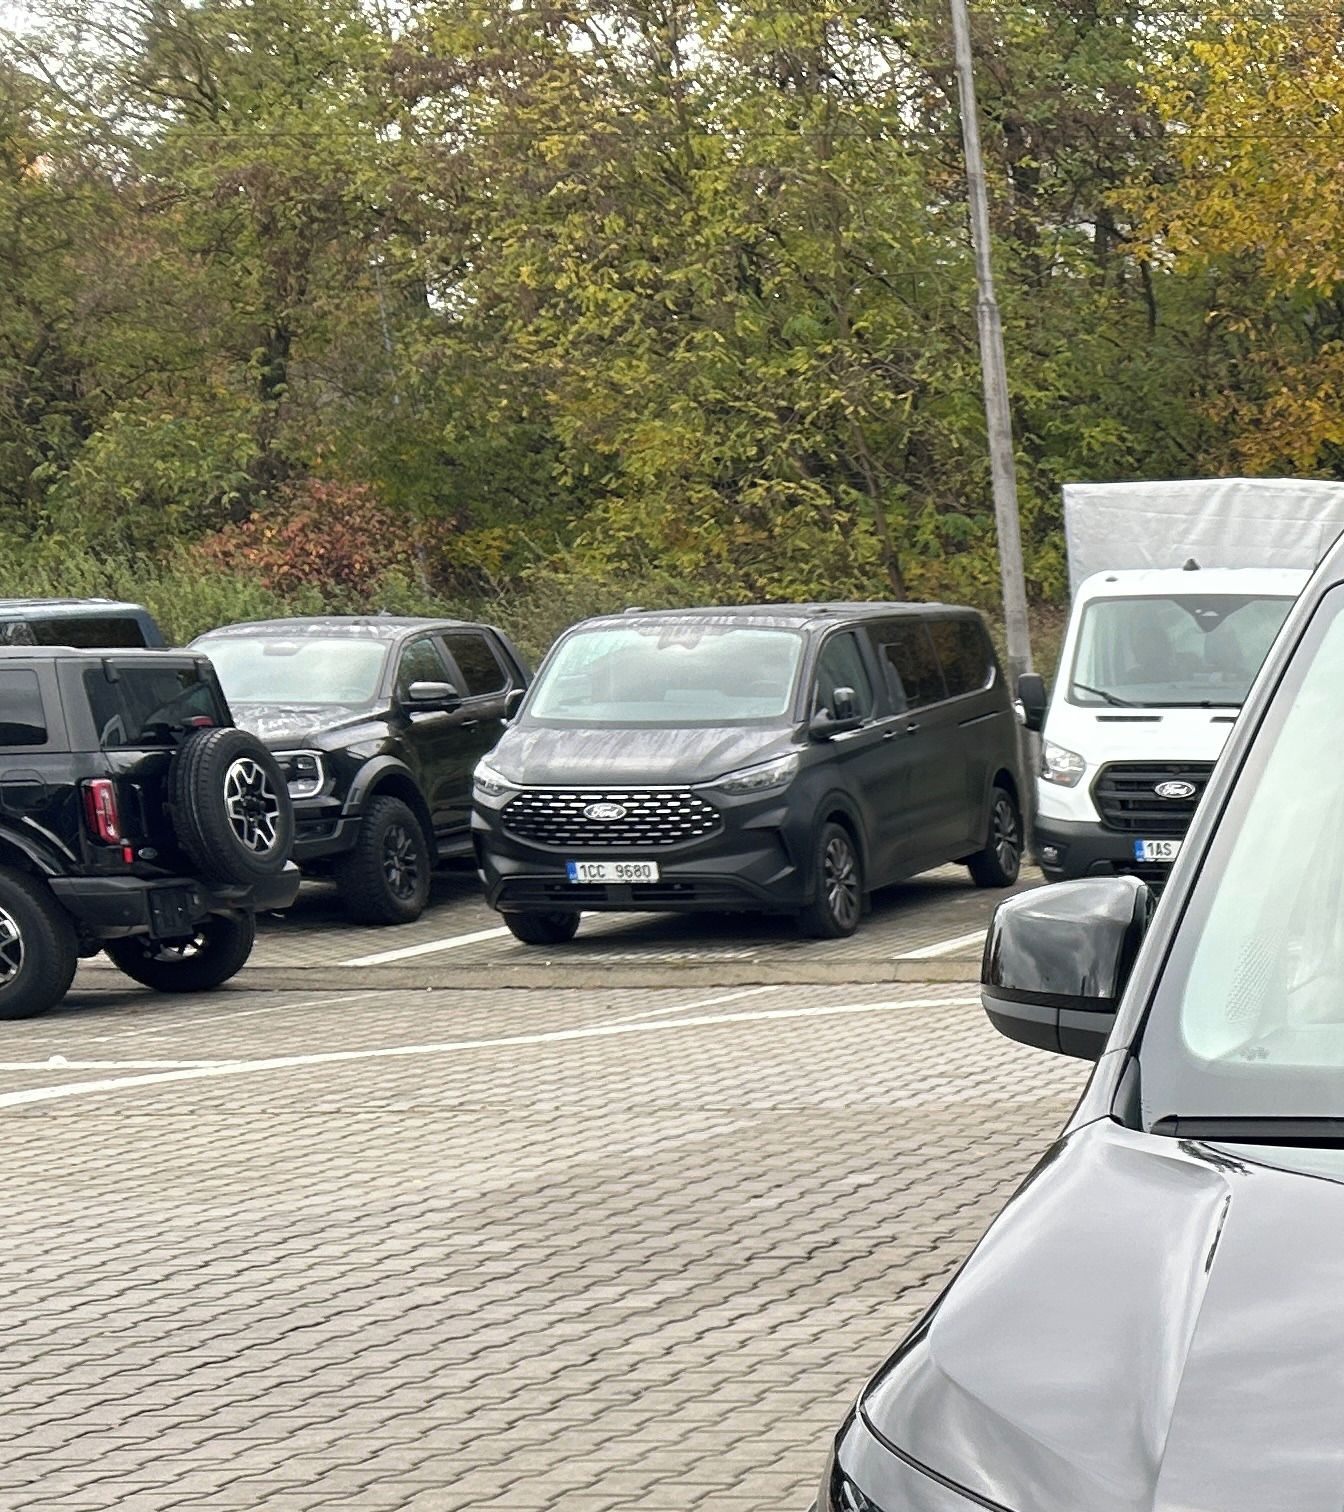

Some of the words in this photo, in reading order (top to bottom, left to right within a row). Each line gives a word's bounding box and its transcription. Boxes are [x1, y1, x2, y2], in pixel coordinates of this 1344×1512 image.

[1147, 842, 1172, 857] 1AS
[580, 864, 606, 878] 1CC
[615, 864, 652, 878] 9680
